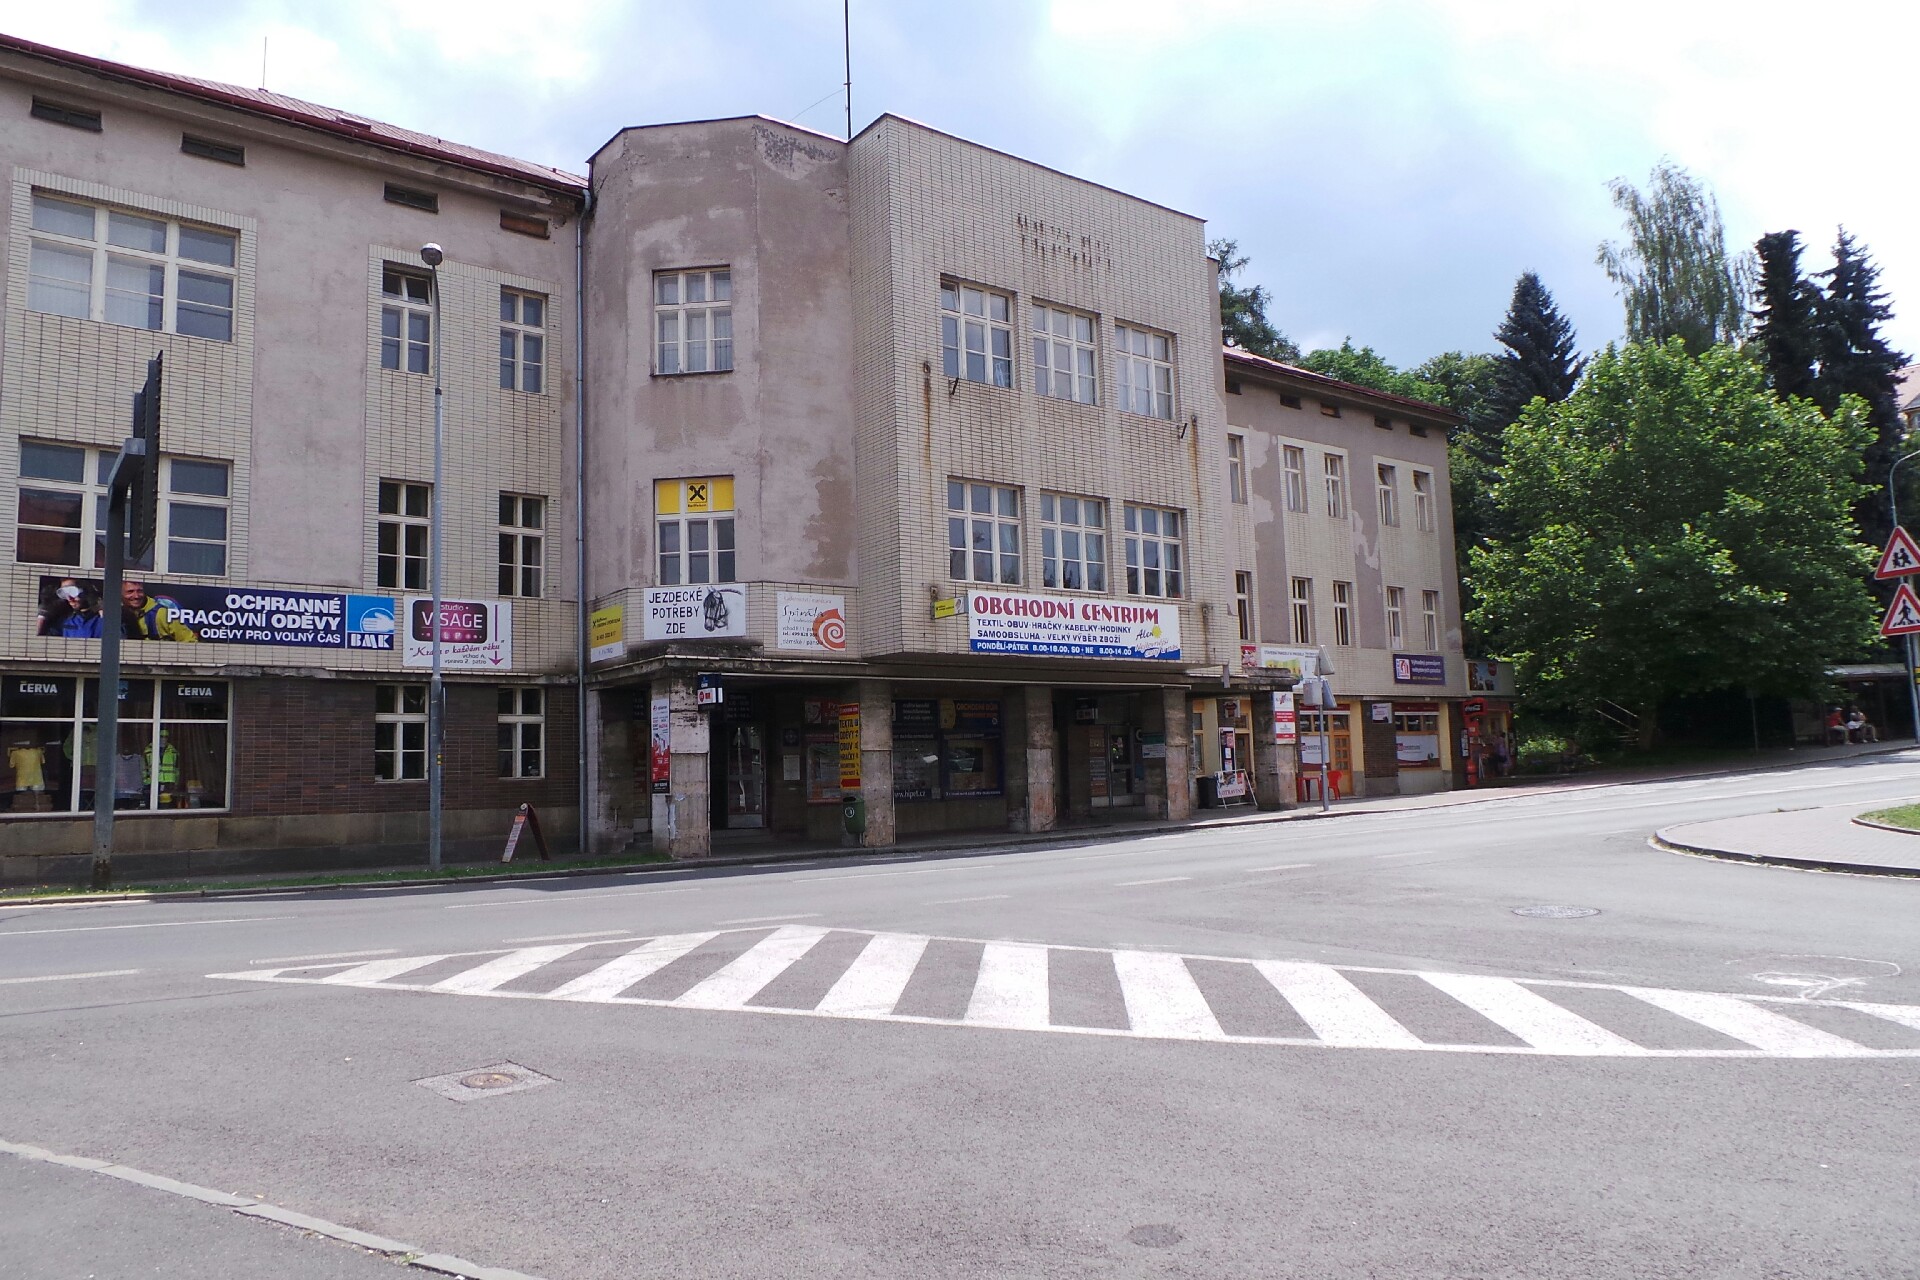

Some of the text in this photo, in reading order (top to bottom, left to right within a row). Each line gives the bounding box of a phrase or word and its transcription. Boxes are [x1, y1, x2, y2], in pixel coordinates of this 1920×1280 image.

[649, 587, 703, 604] JEZDECKÉ
[225, 594, 341, 614] OCHRANNÉ
[652, 604, 700, 619] POTŘEBY
[973, 596, 1159, 624] OBCHODNÍ CENTRUM
[167, 607, 341, 631] PRACOVNÍ ODĚVY
[421, 611, 483, 628] VSAGE
[977, 618, 1132, 634] TEXTIL OBUV HRAČKY KABELKY HODINKY
[200, 626, 341, 644] ODĚVY PRO VOLNÝ ČAS
[666, 623, 686, 634] ZDE
[977, 629, 1121, 643] SAMOOBSLUHA VELKÝ VÝBĚR ZBOŽÍ
[350, 634, 390, 649] BMK
[977, 641, 1029, 651] PONDĚLÍ-PÁTEK
[1085, 646, 1094, 654] NE
[20, 680, 58, 693] ČERVA
[177, 684, 213, 696] ČERVA
